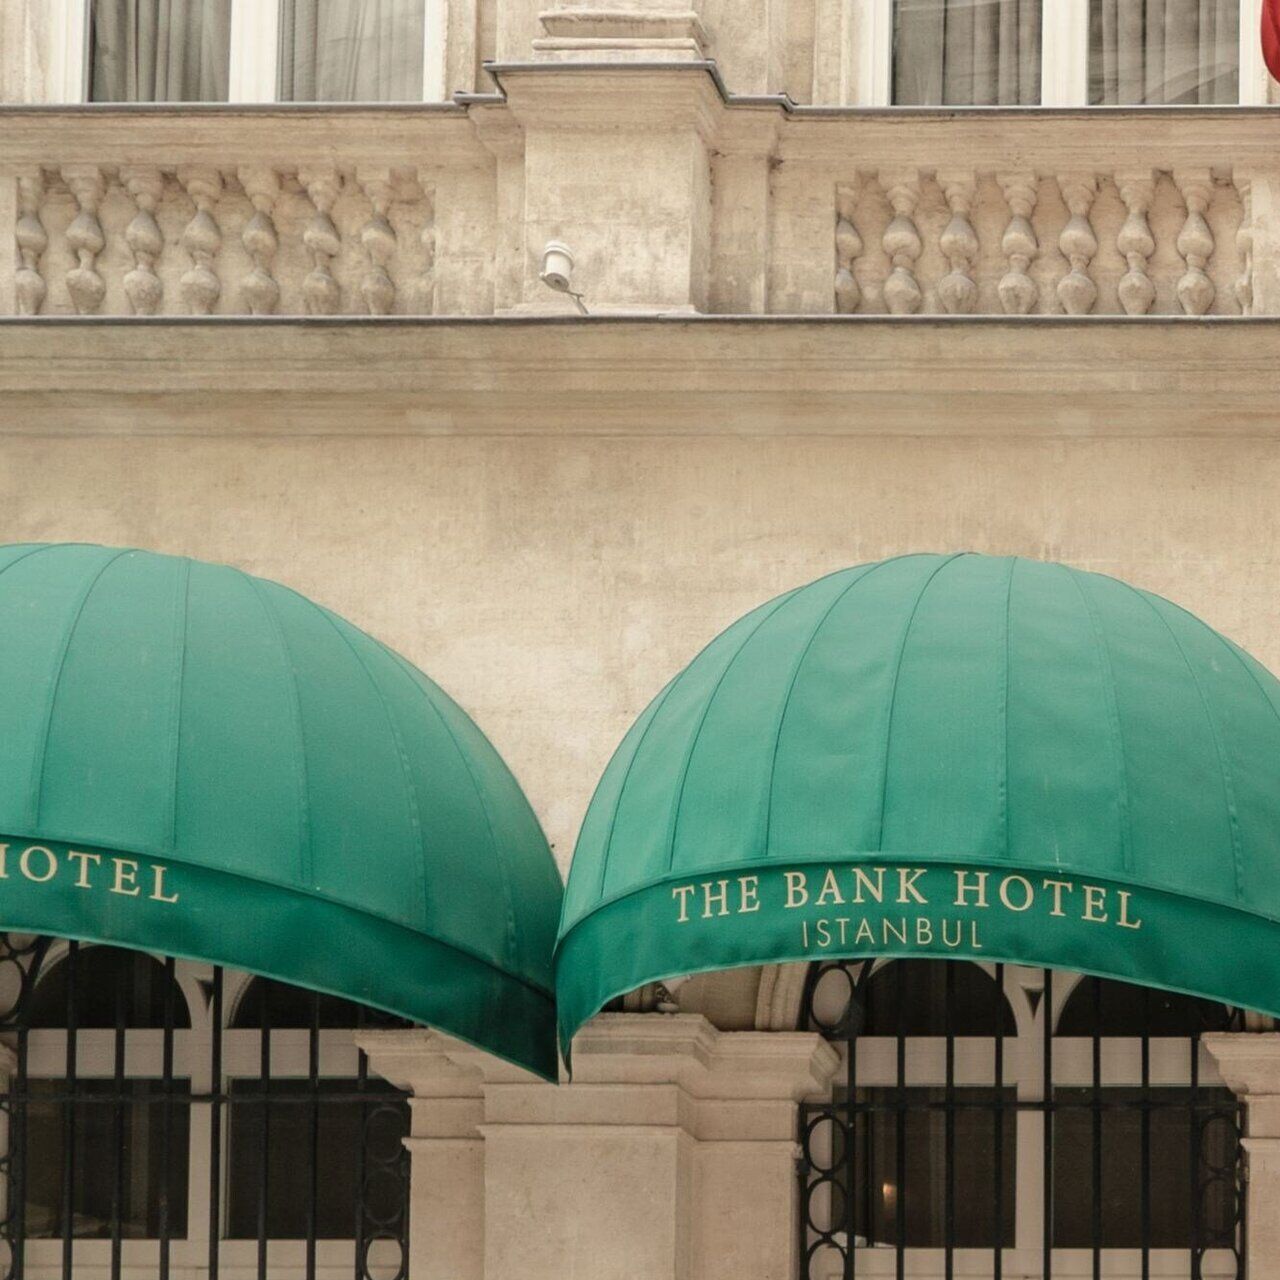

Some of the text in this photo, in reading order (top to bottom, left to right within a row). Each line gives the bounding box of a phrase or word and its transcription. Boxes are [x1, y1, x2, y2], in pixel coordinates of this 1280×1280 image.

[672, 867, 1142, 929] THE BANK HOTEL
[802, 916, 983, 948] ISTANBUL
